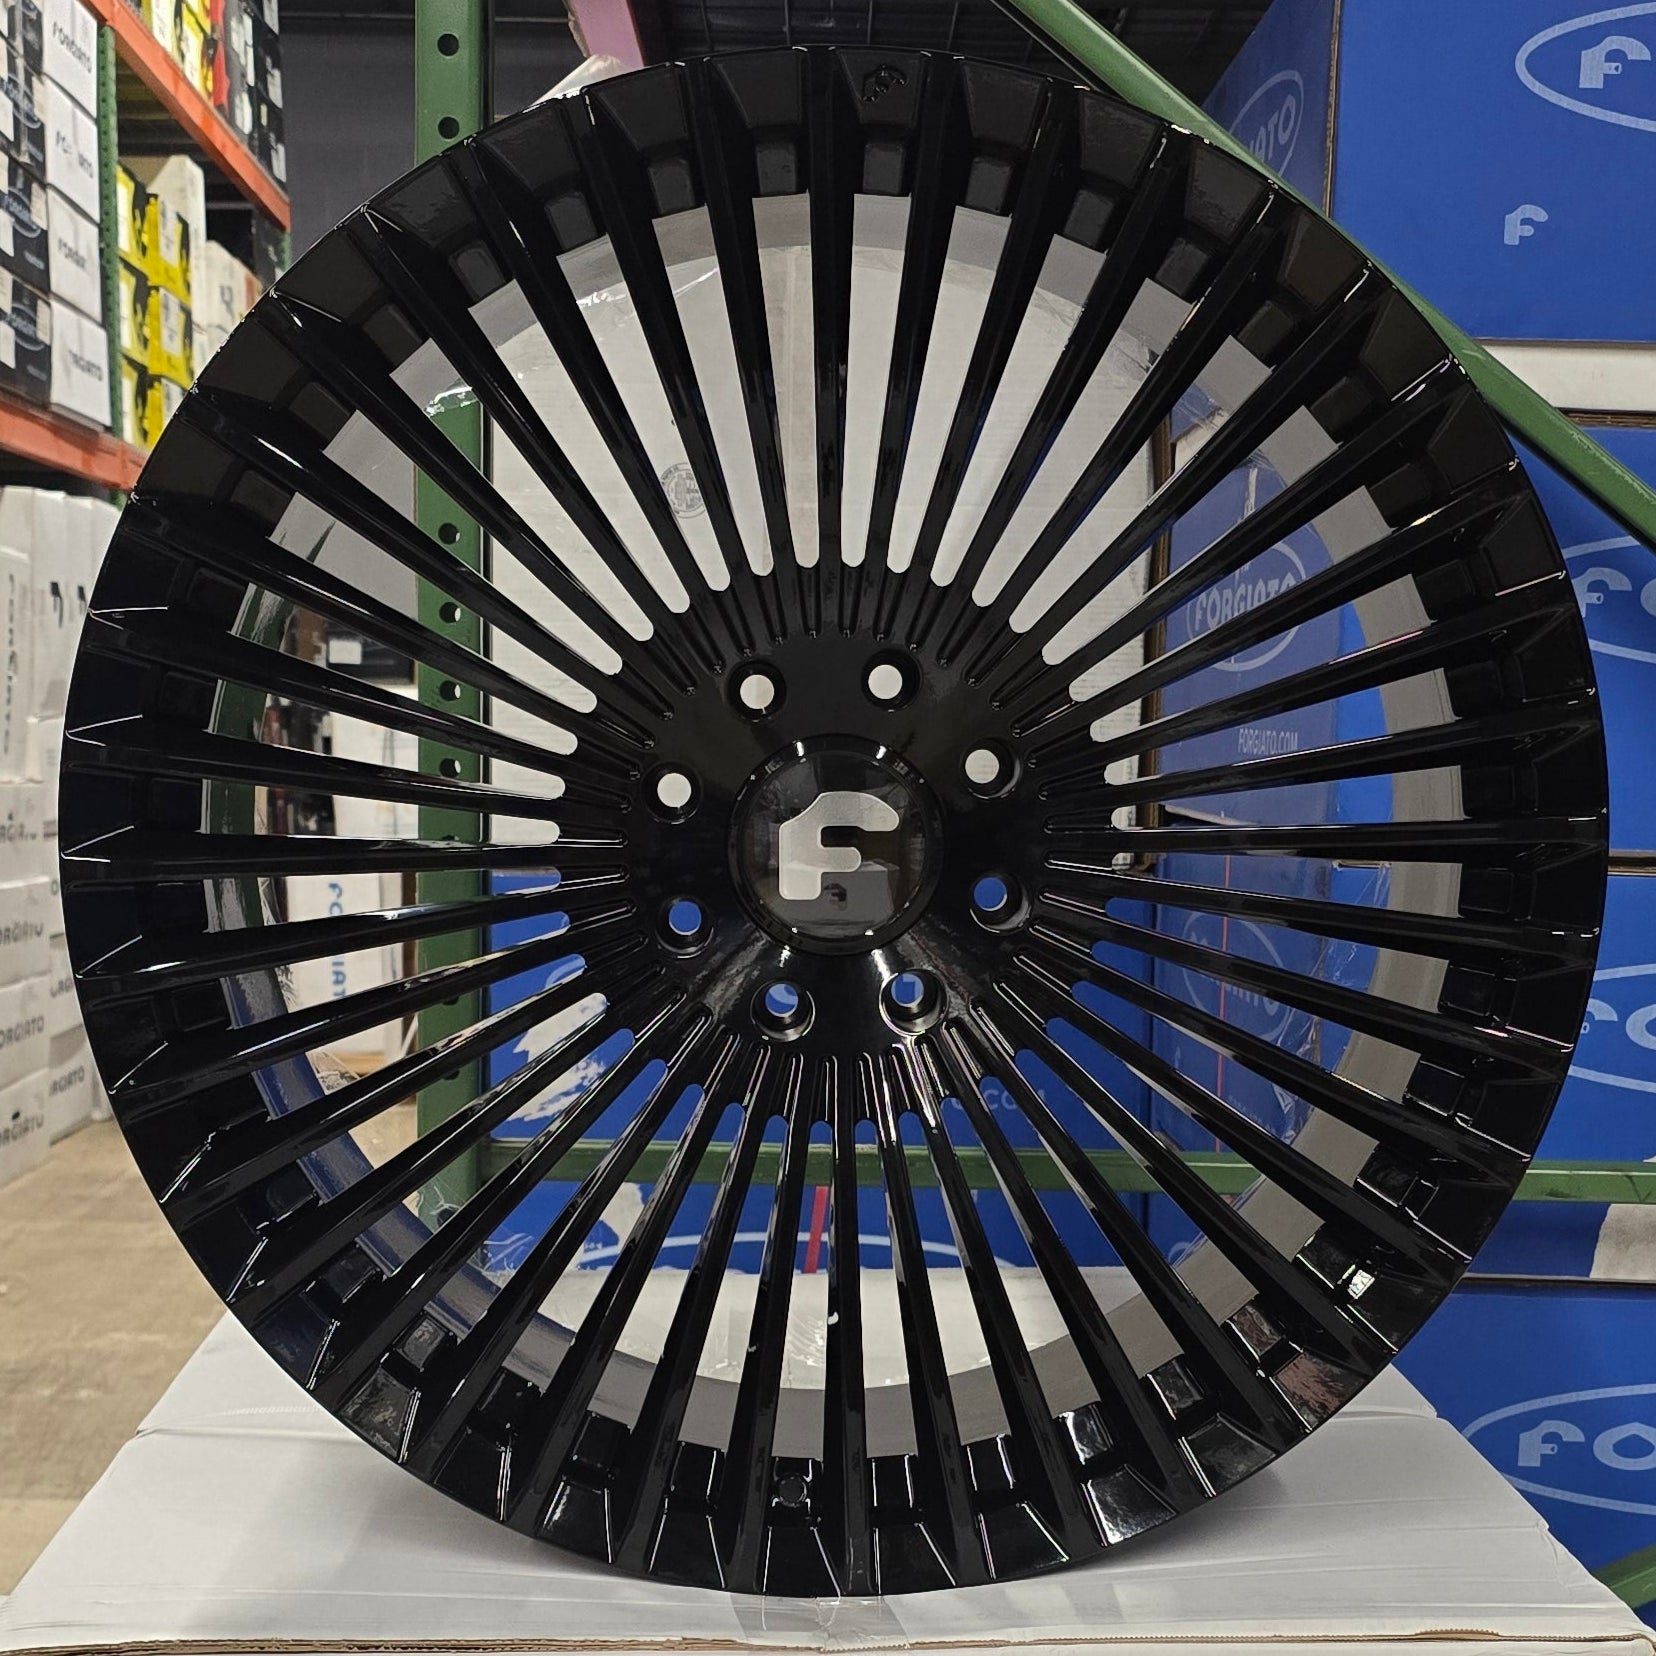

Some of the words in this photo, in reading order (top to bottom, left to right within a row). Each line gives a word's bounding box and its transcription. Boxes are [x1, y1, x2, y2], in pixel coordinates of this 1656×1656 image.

[1504, 204, 1549, 246] F
[1238, 728, 1298, 755] FORGIATO.COM
[778, 790, 900, 901] F
